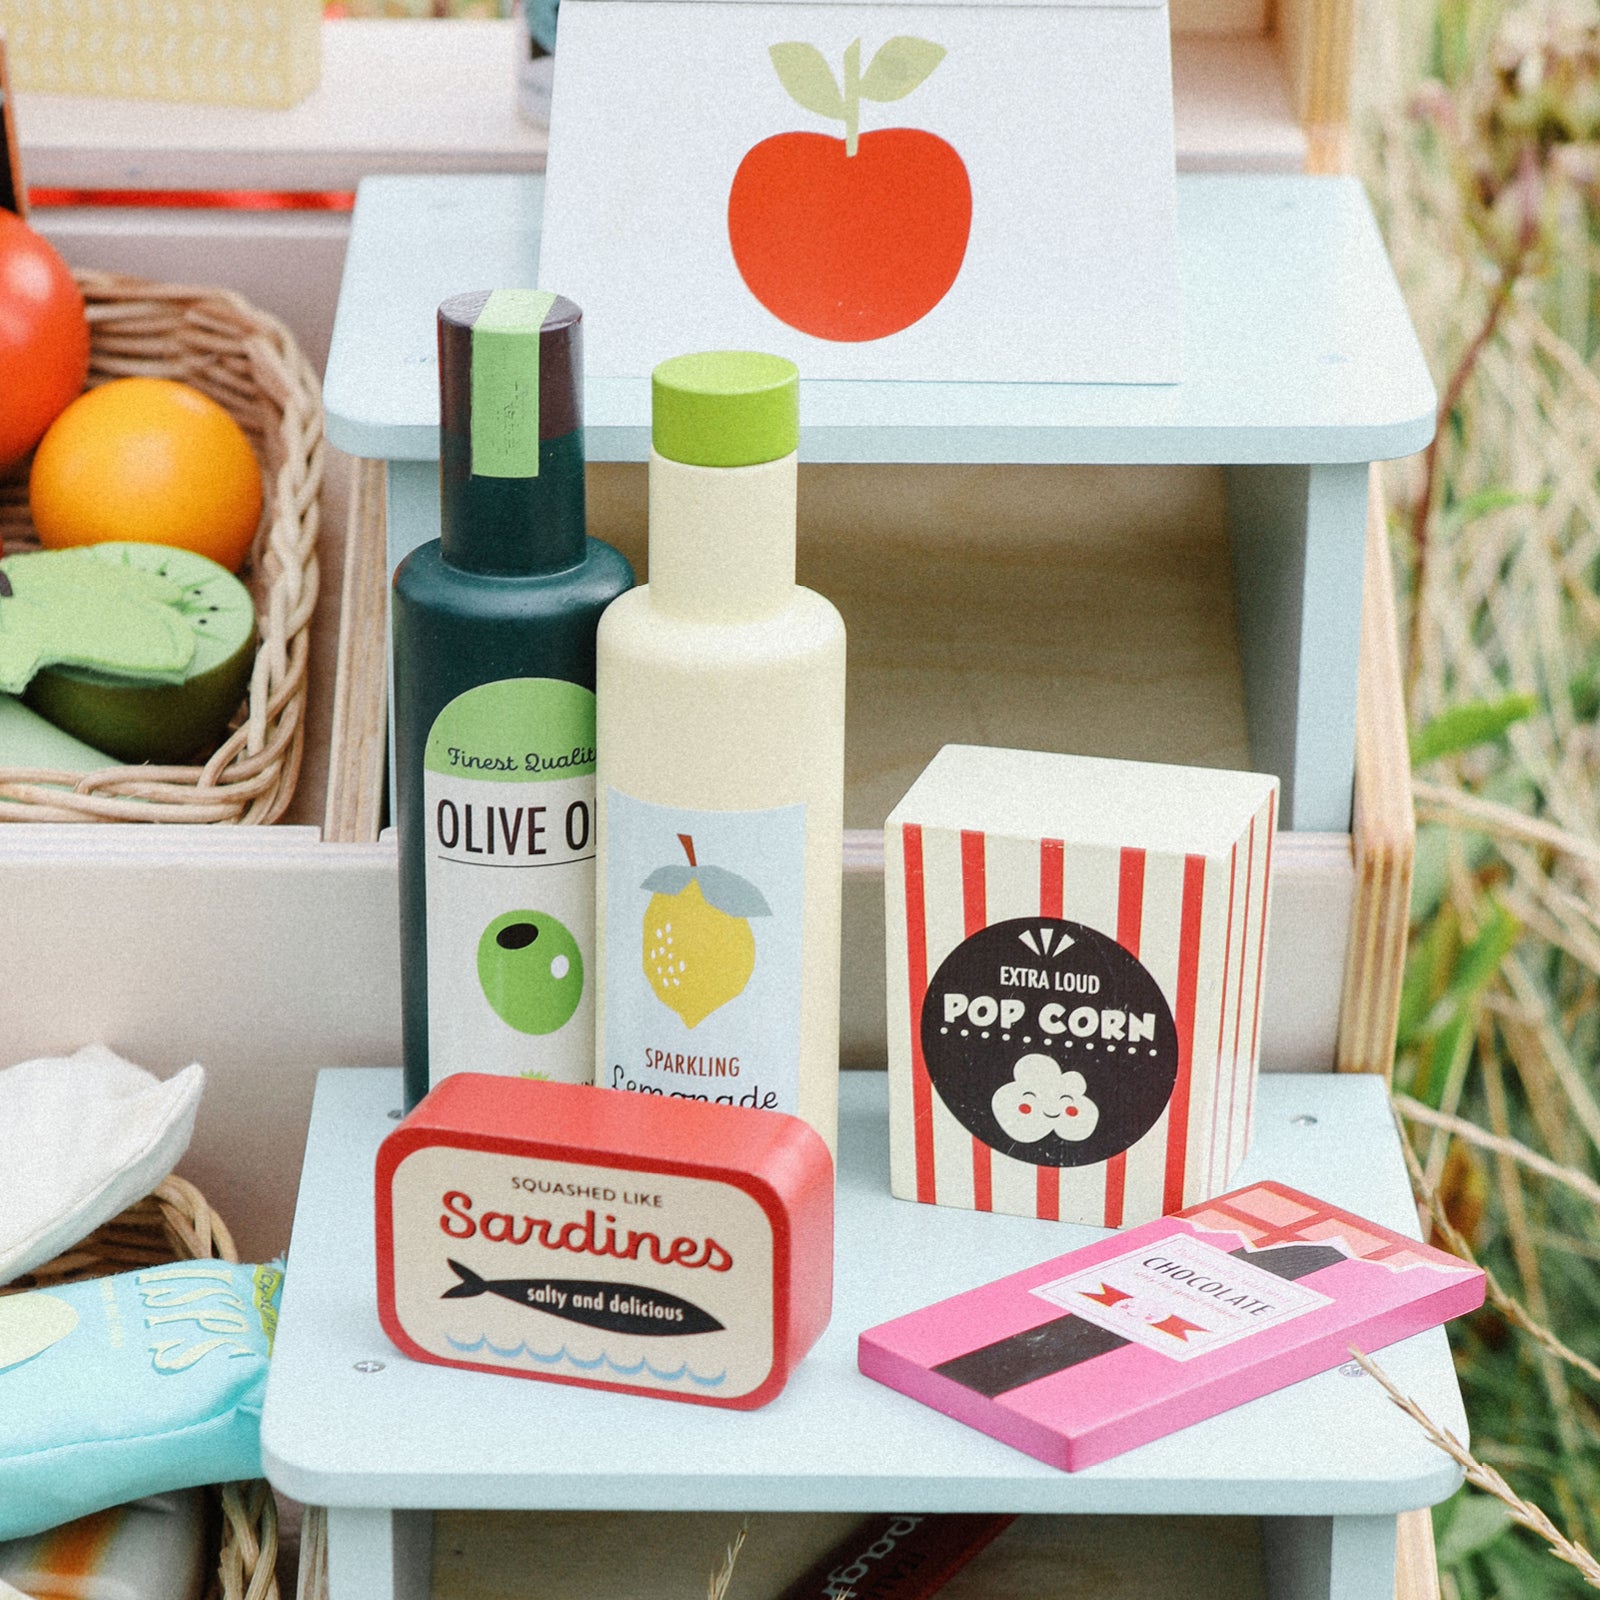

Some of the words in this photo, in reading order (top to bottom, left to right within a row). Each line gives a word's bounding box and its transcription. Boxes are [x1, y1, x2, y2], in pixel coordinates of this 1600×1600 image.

[447, 747, 519, 771] Finest
[524, 747, 596, 773] Qualit
[437, 799, 547, 856] OLIVE
[565, 797, 596, 851] O
[1000, 966, 1050, 990] EXTRA
[1054, 971, 1100, 995] LOUD
[943, 993, 1026, 1030] POP
[1038, 1002, 1156, 1043] CORN
[645, 1048, 741, 1077] SPARKLING
[511, 1176, 617, 1202] SQUASHED
[622, 1190, 664, 1208] LIKE
[440, 1190, 733, 1273] Sardines
[526, 1284, 568, 1310] salty
[572, 1291, 604, 1311] and
[609, 1294, 684, 1322] delicious
[1142, 1256, 1276, 1317] CHOCOLATE
